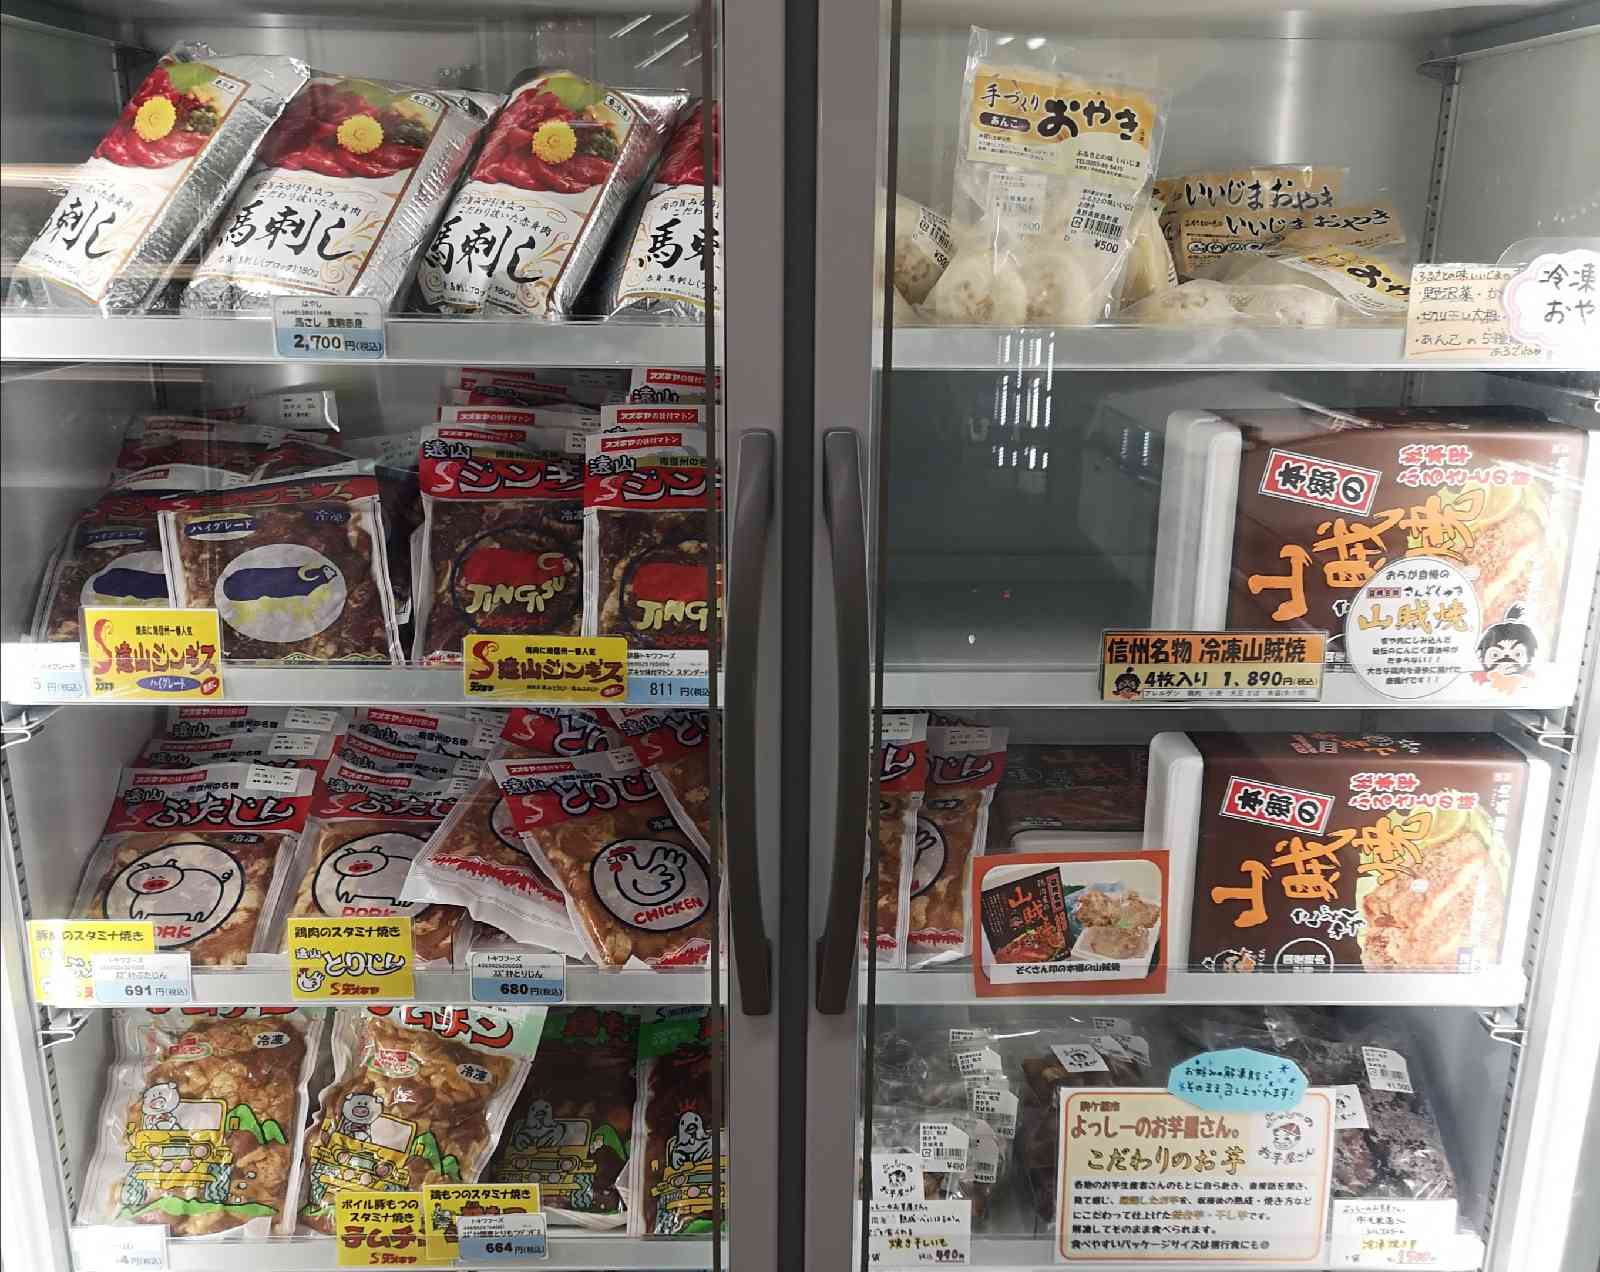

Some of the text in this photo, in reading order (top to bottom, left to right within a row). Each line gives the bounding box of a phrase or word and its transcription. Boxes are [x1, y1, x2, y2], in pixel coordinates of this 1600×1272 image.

[980, 81, 1039, 112] 手づくり
[990, 117, 1019, 129] あんこ
[1037, 98, 1139, 141] おやき
[218, 200, 352, 261] 馬刺し
[425, 216, 543, 283] 馬刺し
[1094, 240, 1119, 254] ¥500
[1538, 263, 1597, 293] 冷凍
[1543, 300, 1596, 325] おや
[293, 334, 341, 352] 2,700
[189, 519, 252, 533] ハイグレード
[1358, 598, 1470, 634] 山賊焼
[1107, 637, 1306, 664] 信州名物 冷凍山賊焼
[649, 681, 673, 696] 811
[1144, 670, 1208, 688] 4枚入り
[145, 792, 296, 828] ぶたじん
[1210, 810, 1434, 928] 山賊焼
[633, 897, 705, 926] CHICKEN
[294, 926, 401, 938] 鶏肉のスタミナ焼き
[322, 950, 406, 977] とりじん
[124, 985, 152, 997] 691
[500, 983, 528, 995] 680
[462, 1064, 489, 1082] 冷凍
[1070, 1115, 1240, 1139] よっしーのお芋屋さん。
[1087, 1146, 1247, 1174] こだわりのお芋
[350, 1212, 415, 1223] スタミナ焼き
[485, 1242, 513, 1254] 664
